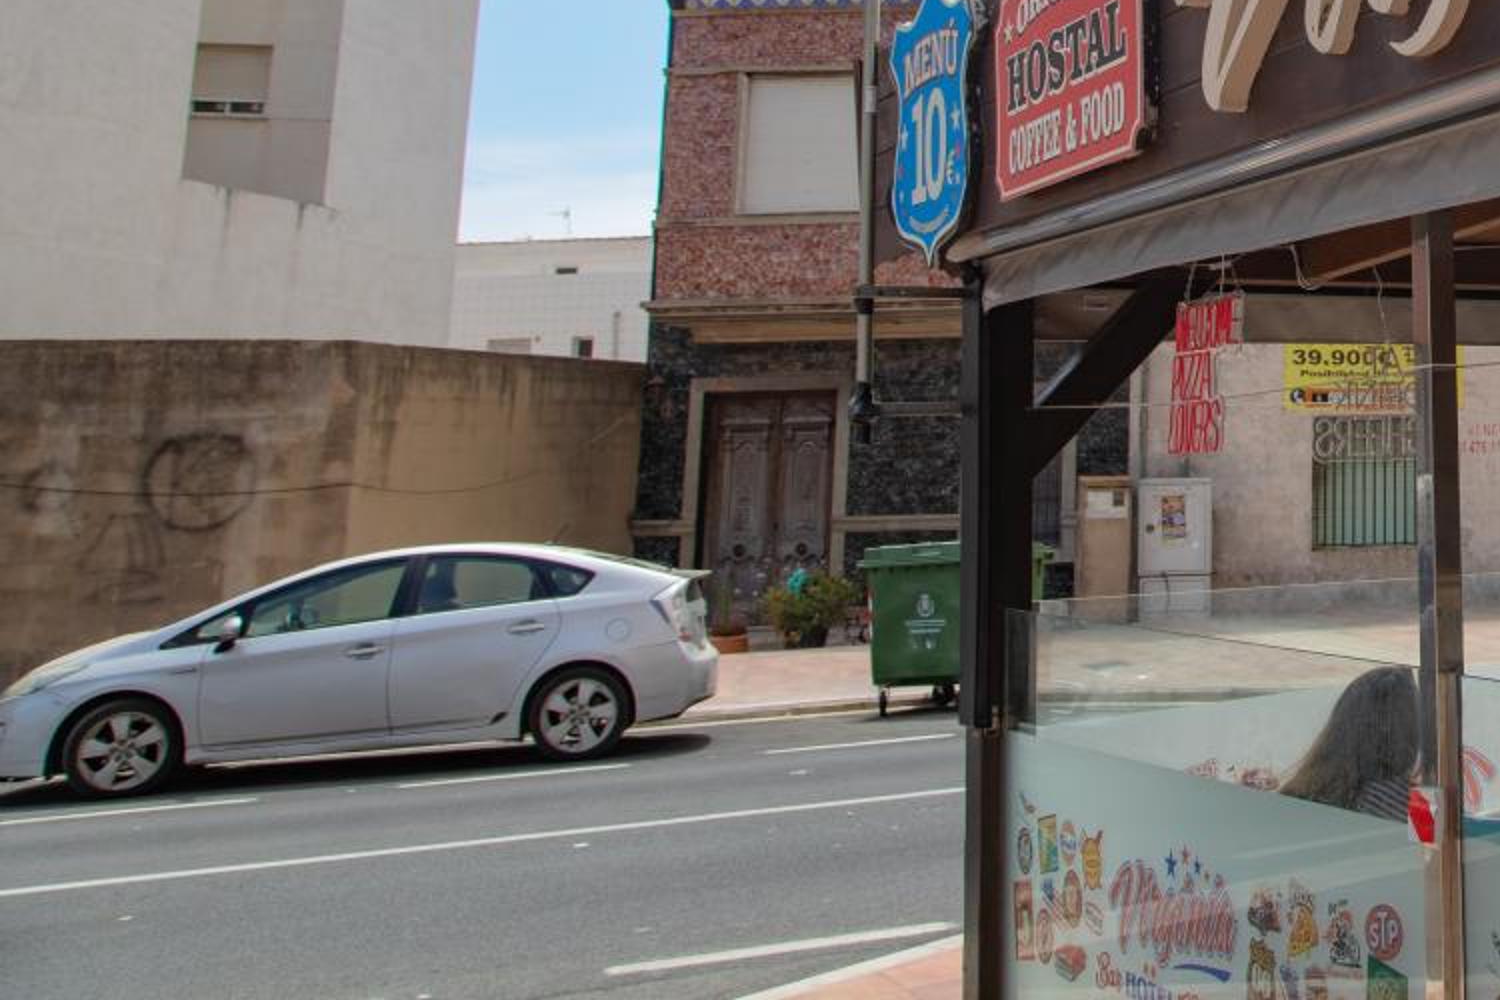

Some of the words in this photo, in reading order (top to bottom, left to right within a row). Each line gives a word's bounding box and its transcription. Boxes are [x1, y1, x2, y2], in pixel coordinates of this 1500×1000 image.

[904, 18, 959, 98] MENÚ
[1009, 112, 1061, 175] COFFEE
[1066, 107, 1078, 151] &
[1080, 81, 1126, 147] FOOD
[1172, 353, 1215, 402] PIZZA
[1108, 858, 1236, 968] Virginia
[1367, 911, 1400, 952] STP
